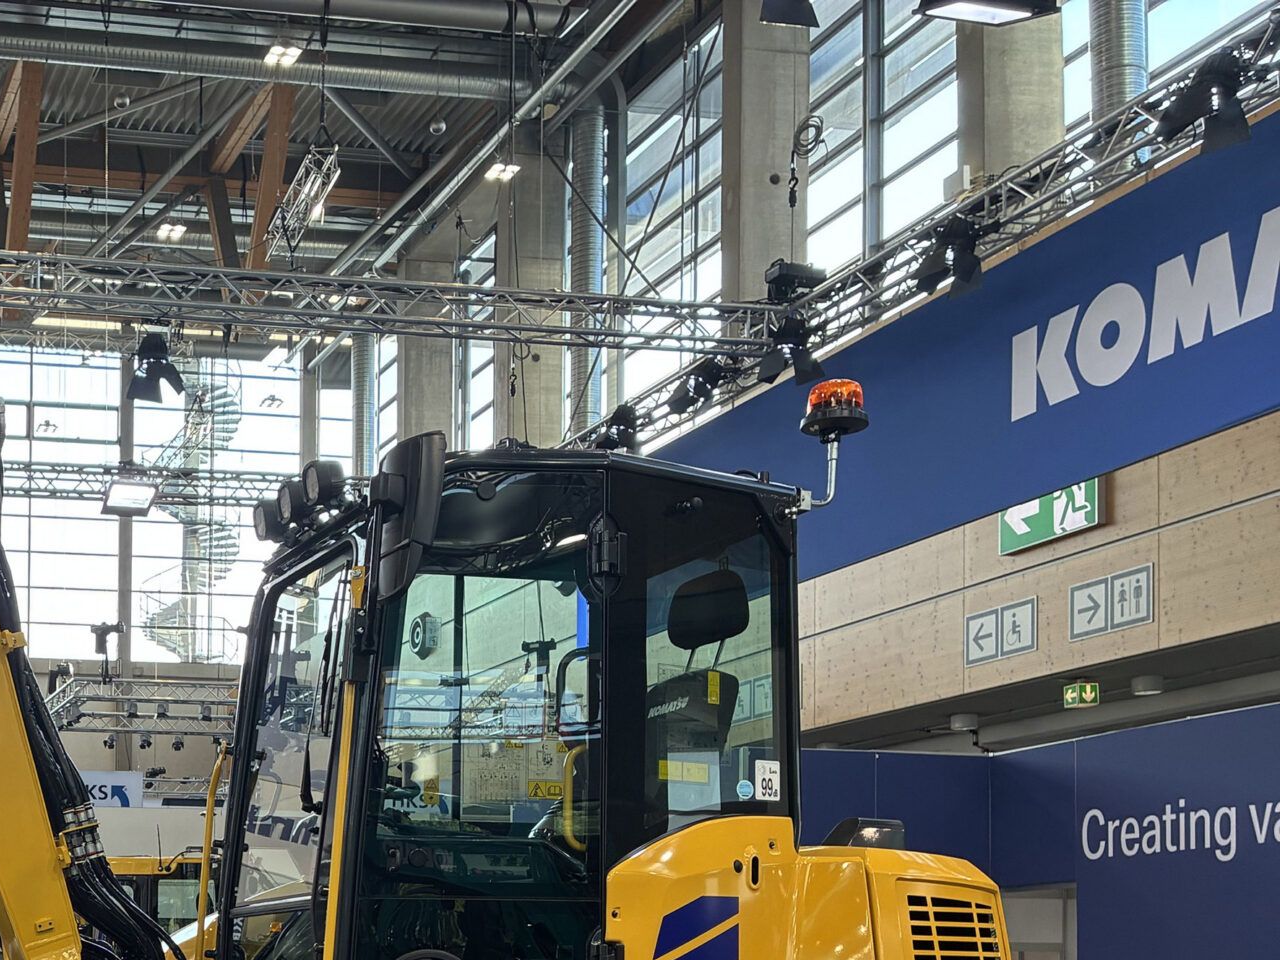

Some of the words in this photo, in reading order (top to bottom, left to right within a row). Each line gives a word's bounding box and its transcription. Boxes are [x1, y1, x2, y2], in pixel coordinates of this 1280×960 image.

[85, 784, 109, 800] KS
[761, 777, 773, 797] 99
[1081, 799, 1237, 862] Creating
